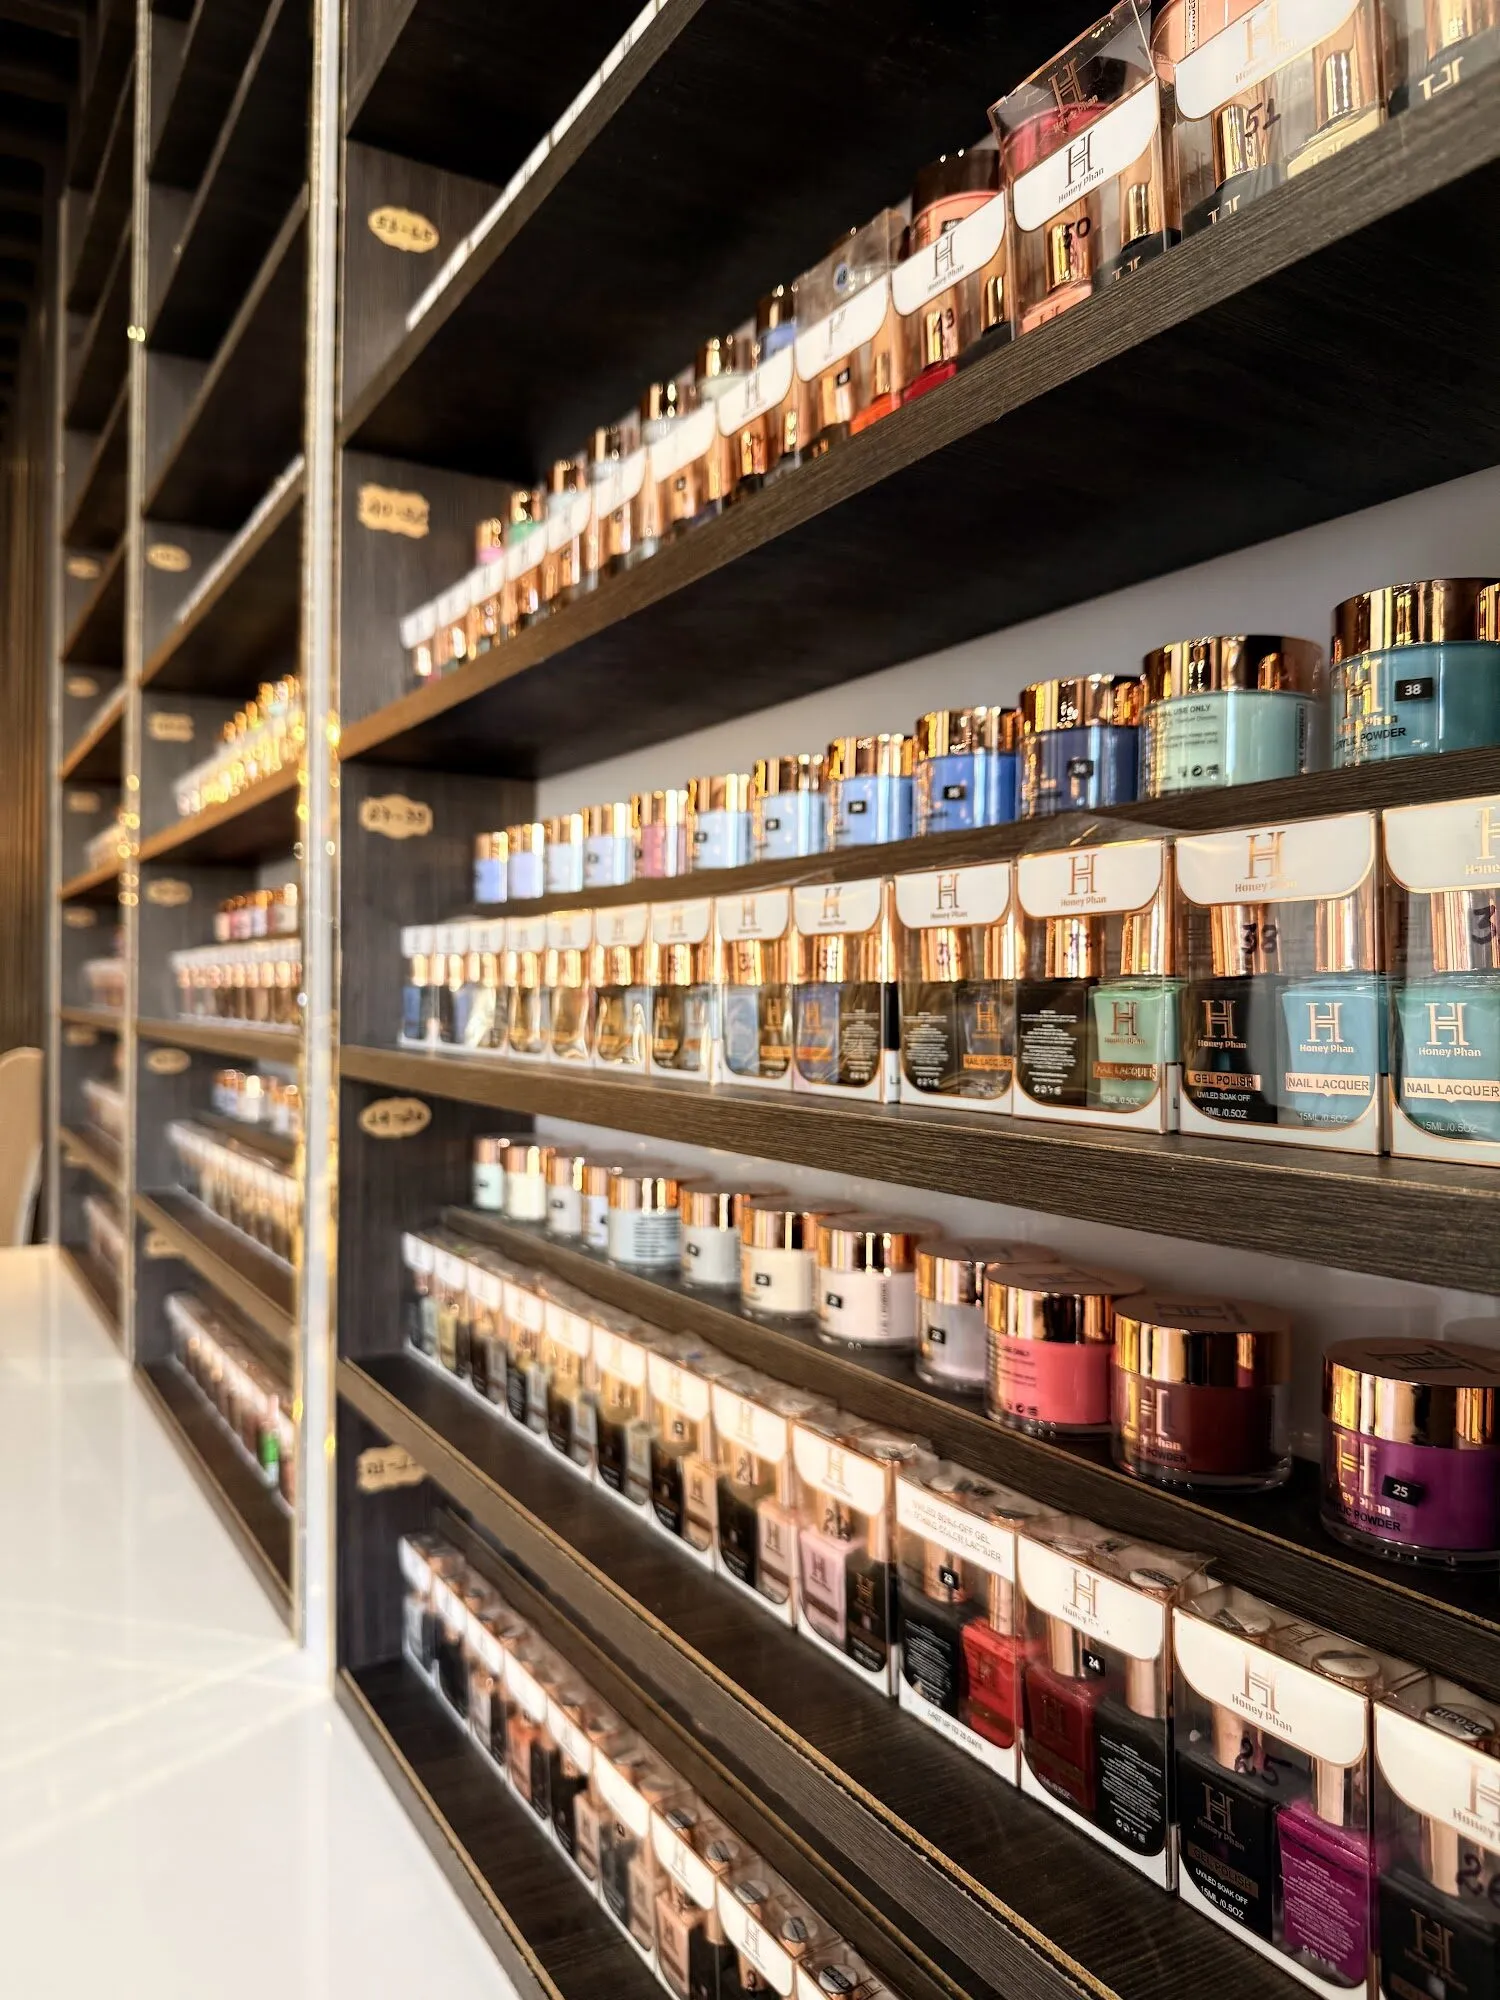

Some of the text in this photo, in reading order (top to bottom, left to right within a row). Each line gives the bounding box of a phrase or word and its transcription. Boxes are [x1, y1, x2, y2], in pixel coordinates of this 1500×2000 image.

[1244, 98, 1281, 138] 51
[1065, 130, 1095, 188] H
[1058, 167, 1105, 204] Honey Phan
[1404, 683, 1422, 696] 38
[1190, 703, 1211, 714] ONLY
[1361, 727, 1407, 741] POWDER
[1246, 831, 1287, 879] H
[1465, 862, 1500, 876] Hone
[1068, 854, 1098, 896] H
[1234, 882, 1268, 894] Honey
[936, 873, 960, 910] H
[1061, 895, 1107, 908] Honey Phan
[1240, 922, 1279, 955] 38
[972, 1001, 996, 1032] H
[1111, 1001, 1138, 1036] H
[1201, 1000, 1238, 1039] H
[1305, 1002, 1345, 1043] H
[1424, 1003, 1470, 1046] H
[1198, 1039, 1247, 1050] Honey Phan
[1299, 1044, 1354, 1054] Honey Phan
[1418, 1047, 1482, 1057] Honey Phan
[1194, 1073, 1253, 1087] GEL POLISH
[1287, 1077, 1370, 1091] NAIL LACQUER
[1406, 1082, 1500, 1097] NAIL LACQUER
[1201, 1106, 1221, 1116] 15ML
[1220, 1093, 1237, 1101] SOAK
[1238, 1094, 1251, 1102] OFF
[1392, 1484, 1409, 1498] 25
[1354, 1509, 1401, 1532] POWDER
[972, 1529, 993, 1546] GEL
[1069, 1566, 1100, 1618] H
[1089, 1656, 1100, 1671] 24
[1240, 1652, 1280, 1715] H
[1231, 1693, 1293, 1734] Honey Phan
[1434, 1707, 1486, 1737] HP026
[1234, 1735, 1293, 1787] 25
[1202, 1782, 1236, 1837] H
[1453, 1808, 1494, 1841] Honey
[1200, 1885, 1219, 1904] 15ML
[1217, 1881, 1235, 1899] SOAK
[1235, 1893, 1249, 1907] OFF
[1410, 1907, 1455, 1976] H
